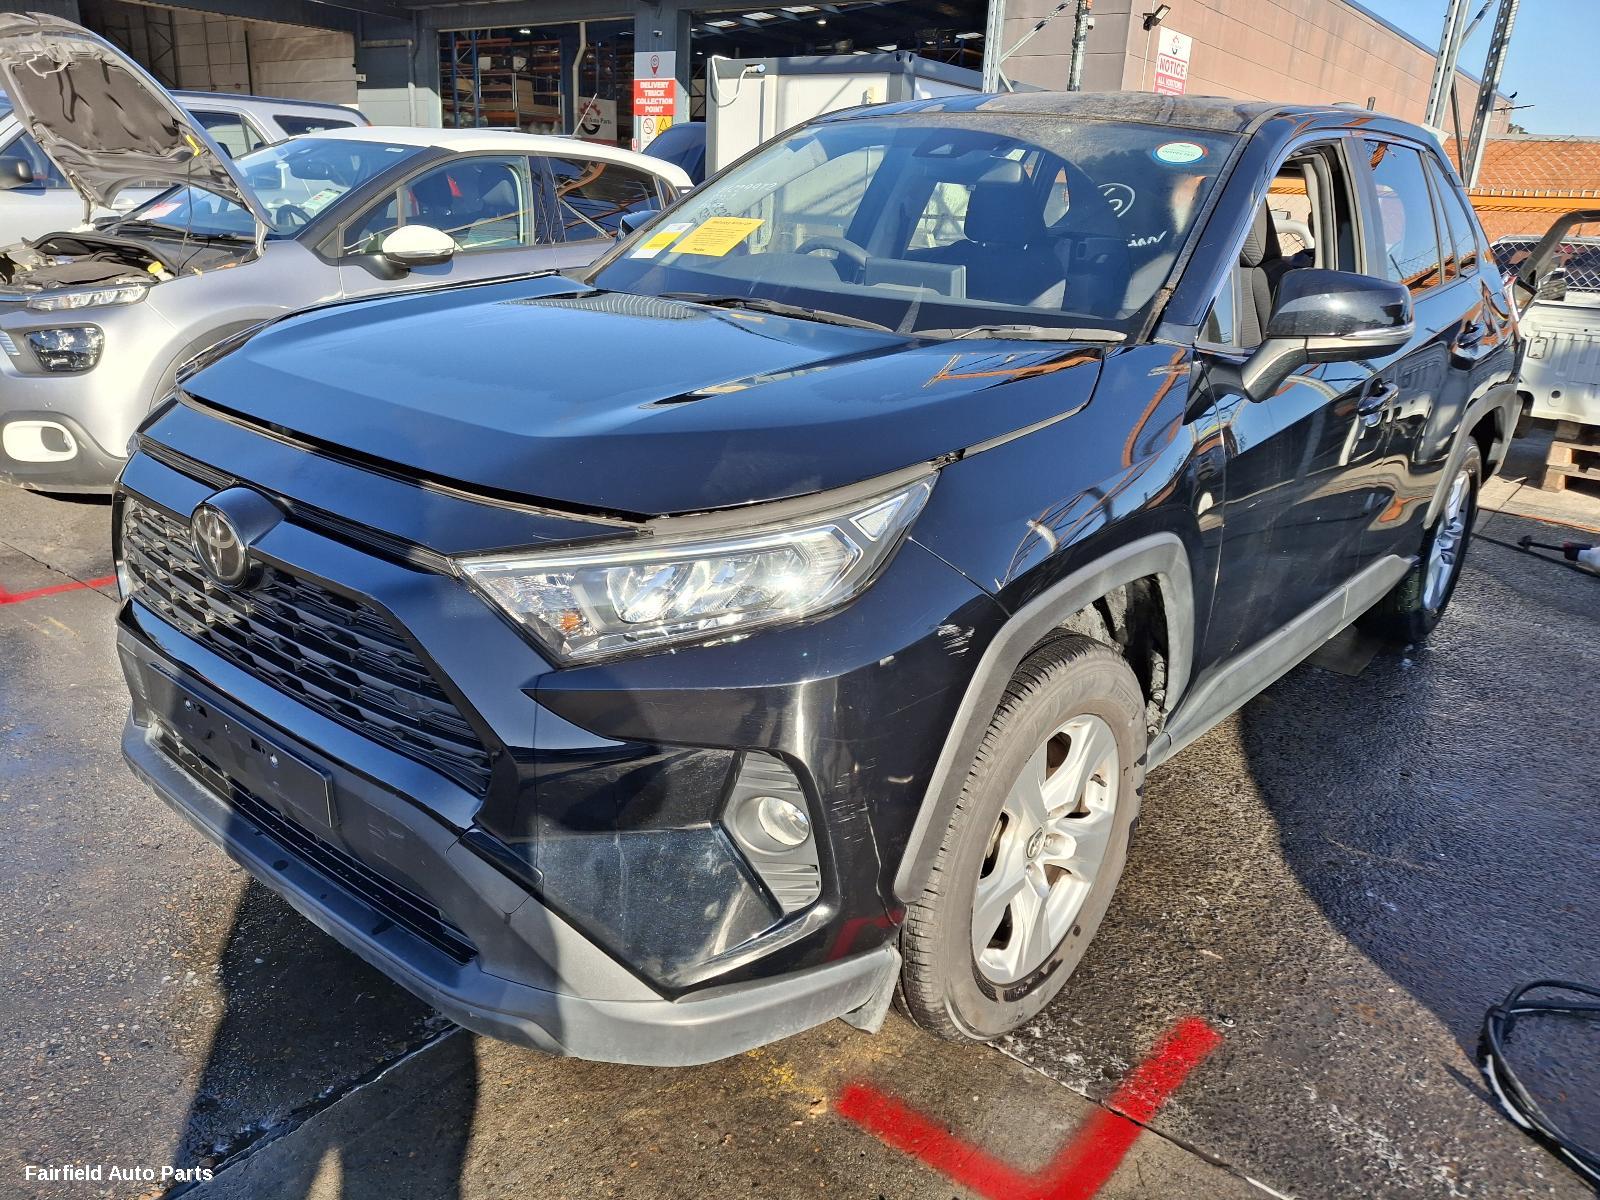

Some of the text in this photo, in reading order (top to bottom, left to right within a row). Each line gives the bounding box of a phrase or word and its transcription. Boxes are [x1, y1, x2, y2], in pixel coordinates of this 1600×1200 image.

[1160, 58, 1185, 77] NOTICE
[640, 81, 669, 89] DELIVERY
[635, 97, 673, 105] COLLECTION
[645, 105, 664, 113] POINT
